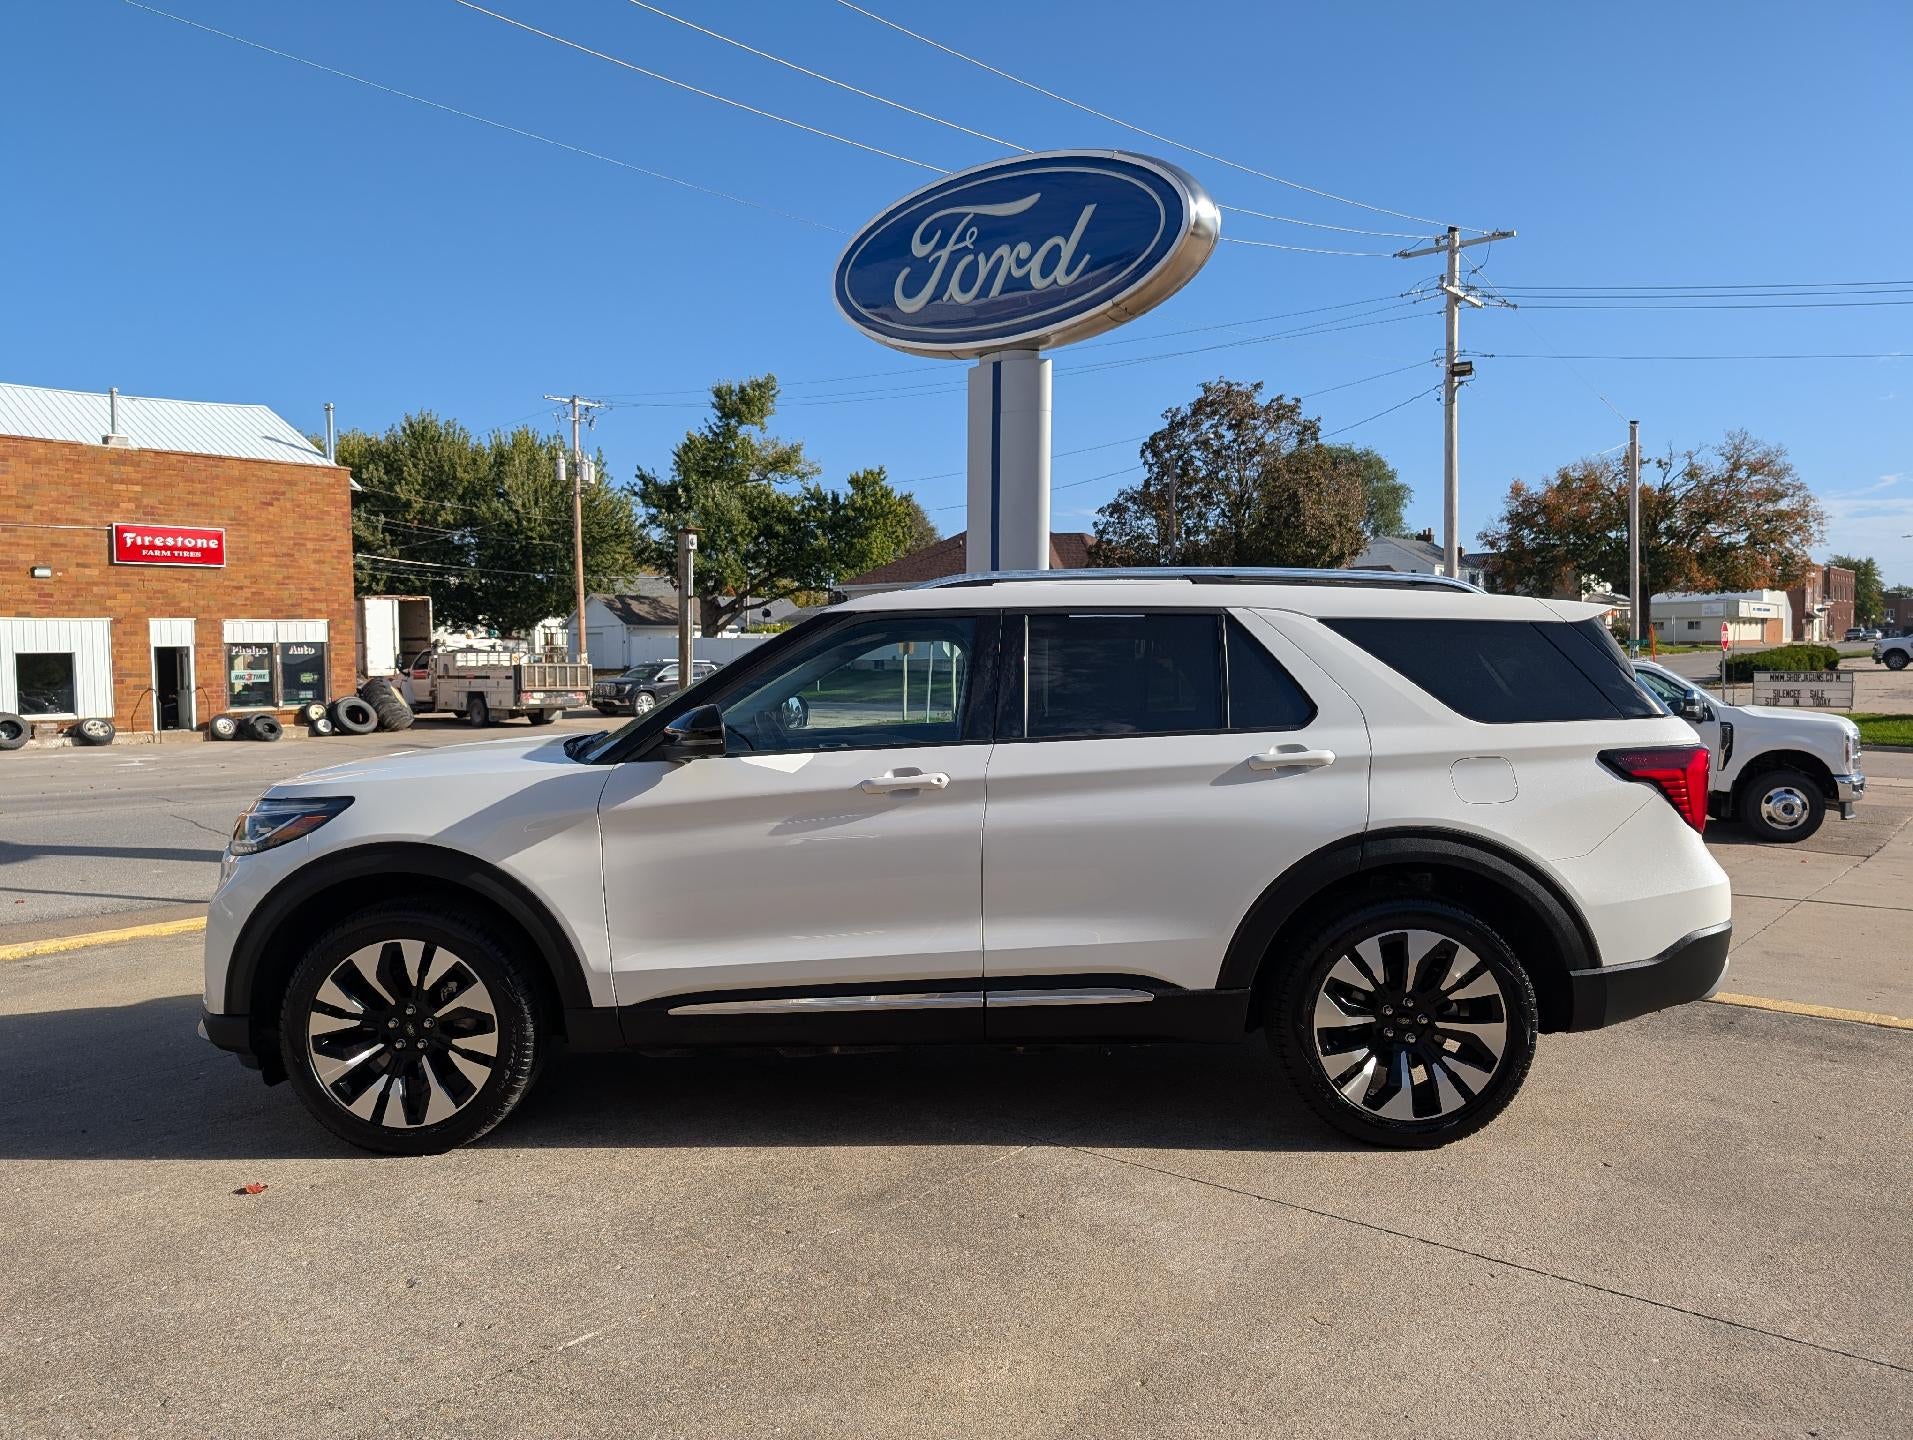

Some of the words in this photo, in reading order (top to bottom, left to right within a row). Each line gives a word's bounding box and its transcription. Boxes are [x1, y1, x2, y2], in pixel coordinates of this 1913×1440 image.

[894, 192, 1097, 314] Ford
[123, 532, 219, 549] Firestone
[142, 549, 171, 557] FARM
[173, 550, 202, 558] TIRES
[231, 645, 268, 657] Phelps
[288, 645, 316, 655] Auto
[1812, 698, 1831, 706] TODAY
